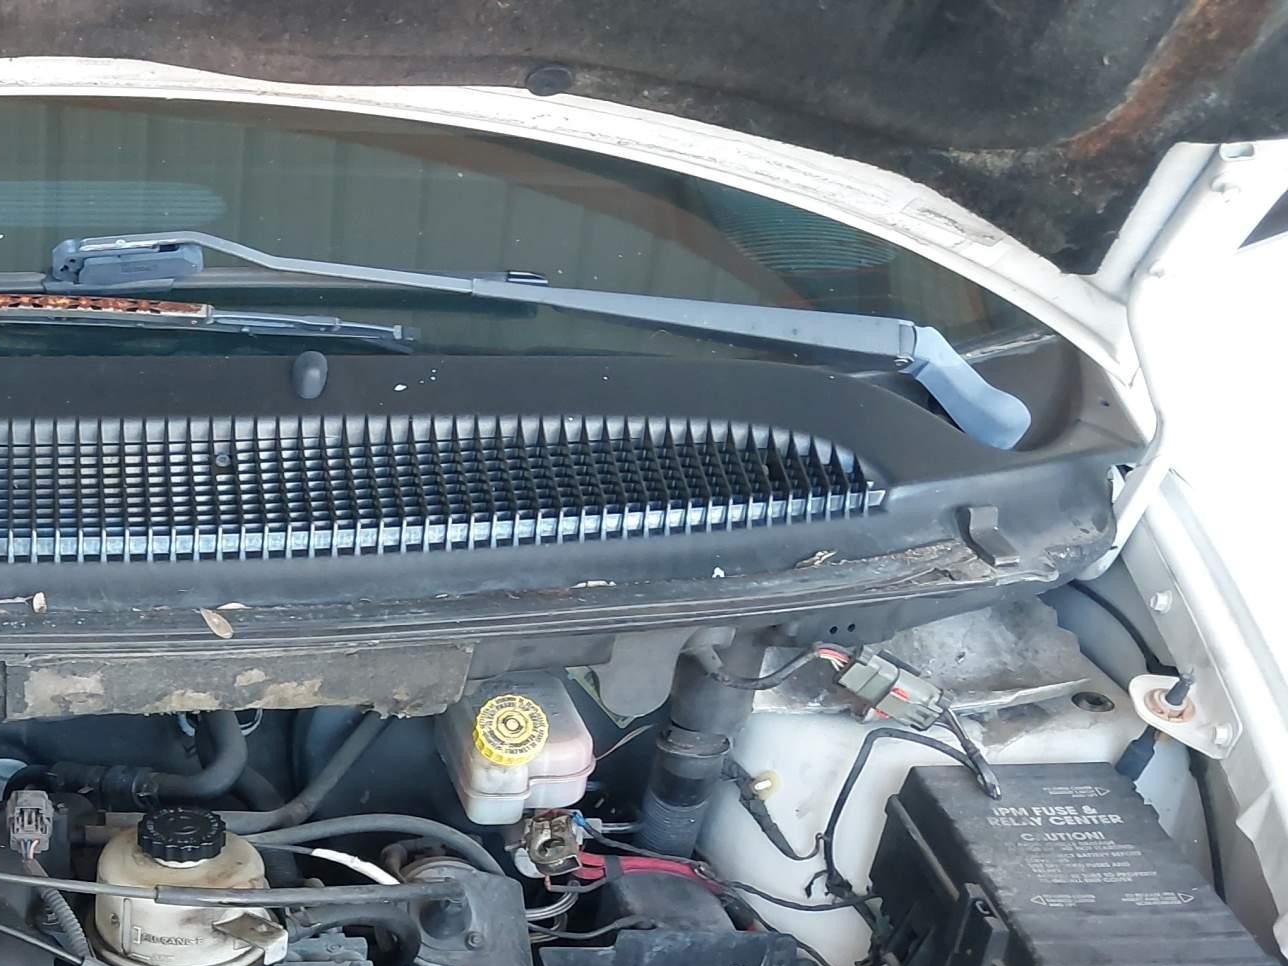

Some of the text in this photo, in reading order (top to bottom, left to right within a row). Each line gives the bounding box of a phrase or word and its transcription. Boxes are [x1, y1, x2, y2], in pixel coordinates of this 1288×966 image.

[992, 805, 1098, 817] IPM FUSE &
[1049, 814, 1125, 826] CENTER
[1020, 831, 1105, 841] CUTION!
